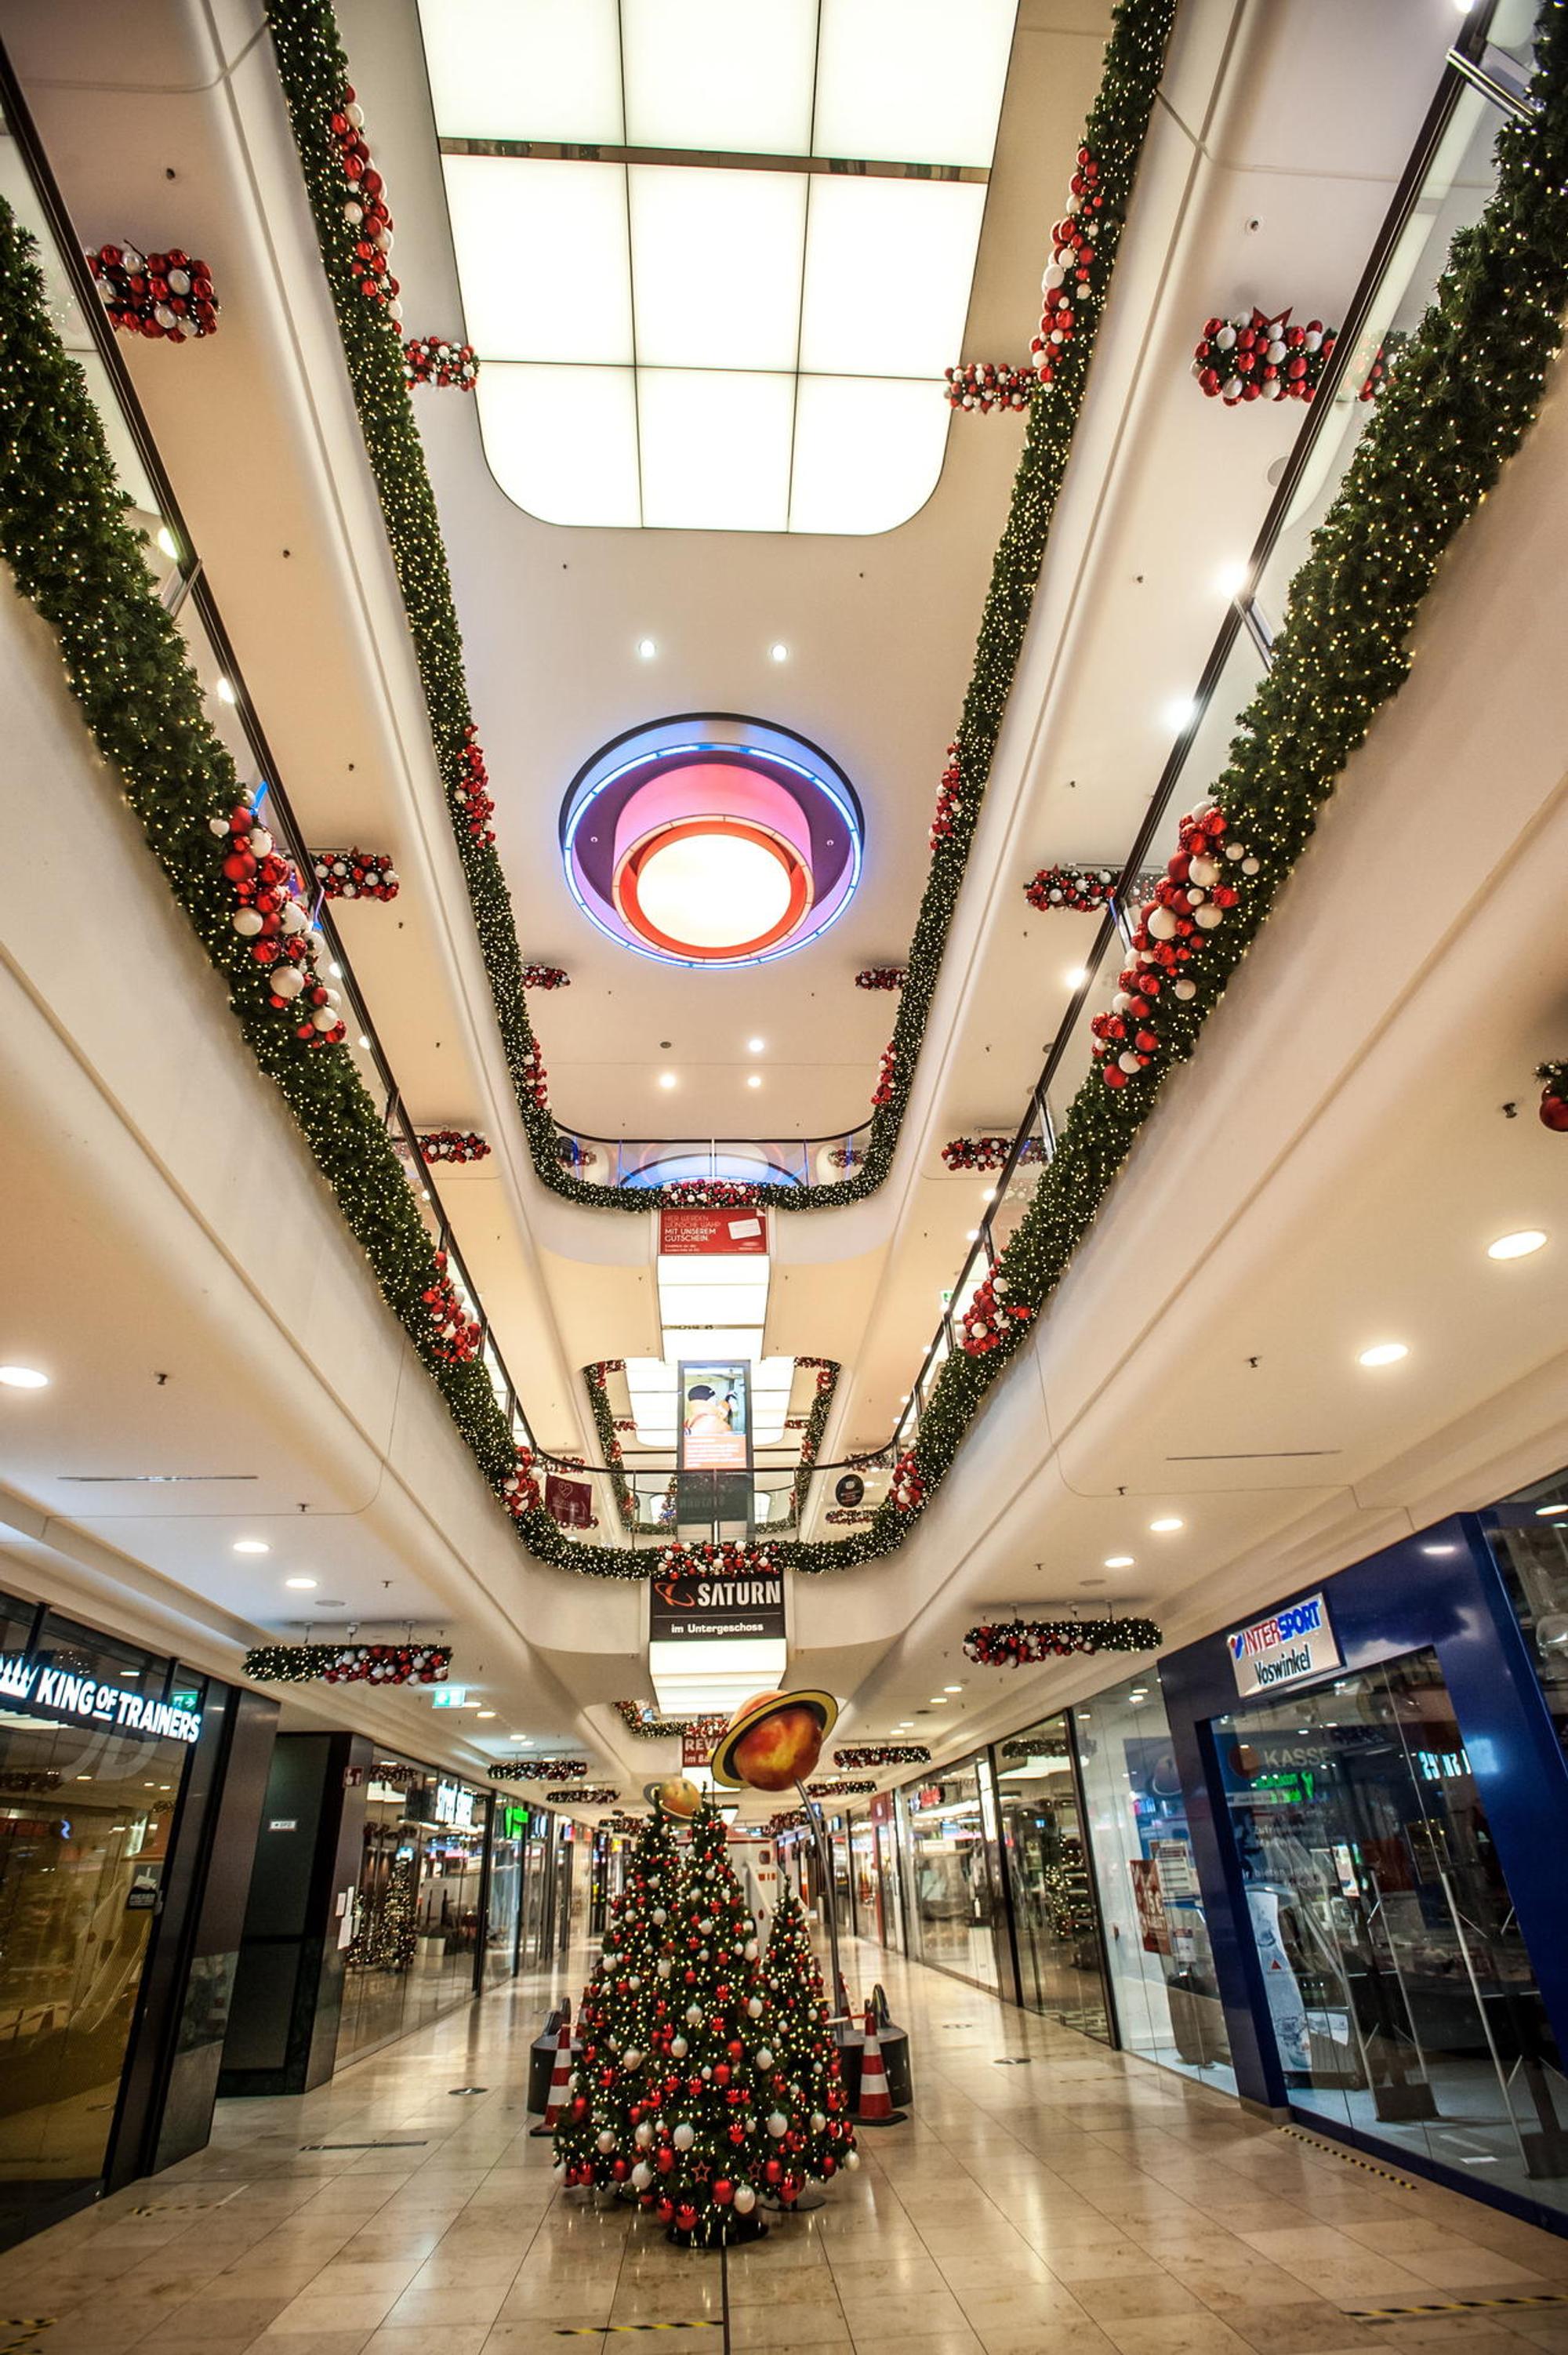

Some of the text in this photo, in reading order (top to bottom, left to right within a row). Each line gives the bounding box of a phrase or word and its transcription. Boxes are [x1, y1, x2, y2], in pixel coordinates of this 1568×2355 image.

[697, 1580, 782, 1606] SATURN
[671, 1623, 764, 1635] im Untergeschoss
[1243, 1601, 1322, 1656] INTERSPORT
[1254, 1643, 1312, 1686] Voswinkel
[35, 1667, 201, 1743] KING OF TRAINERS
[685, 1738, 721, 1751] REW
[684, 1754, 696, 1763] im
[1264, 1747, 1331, 1767] KASSE
